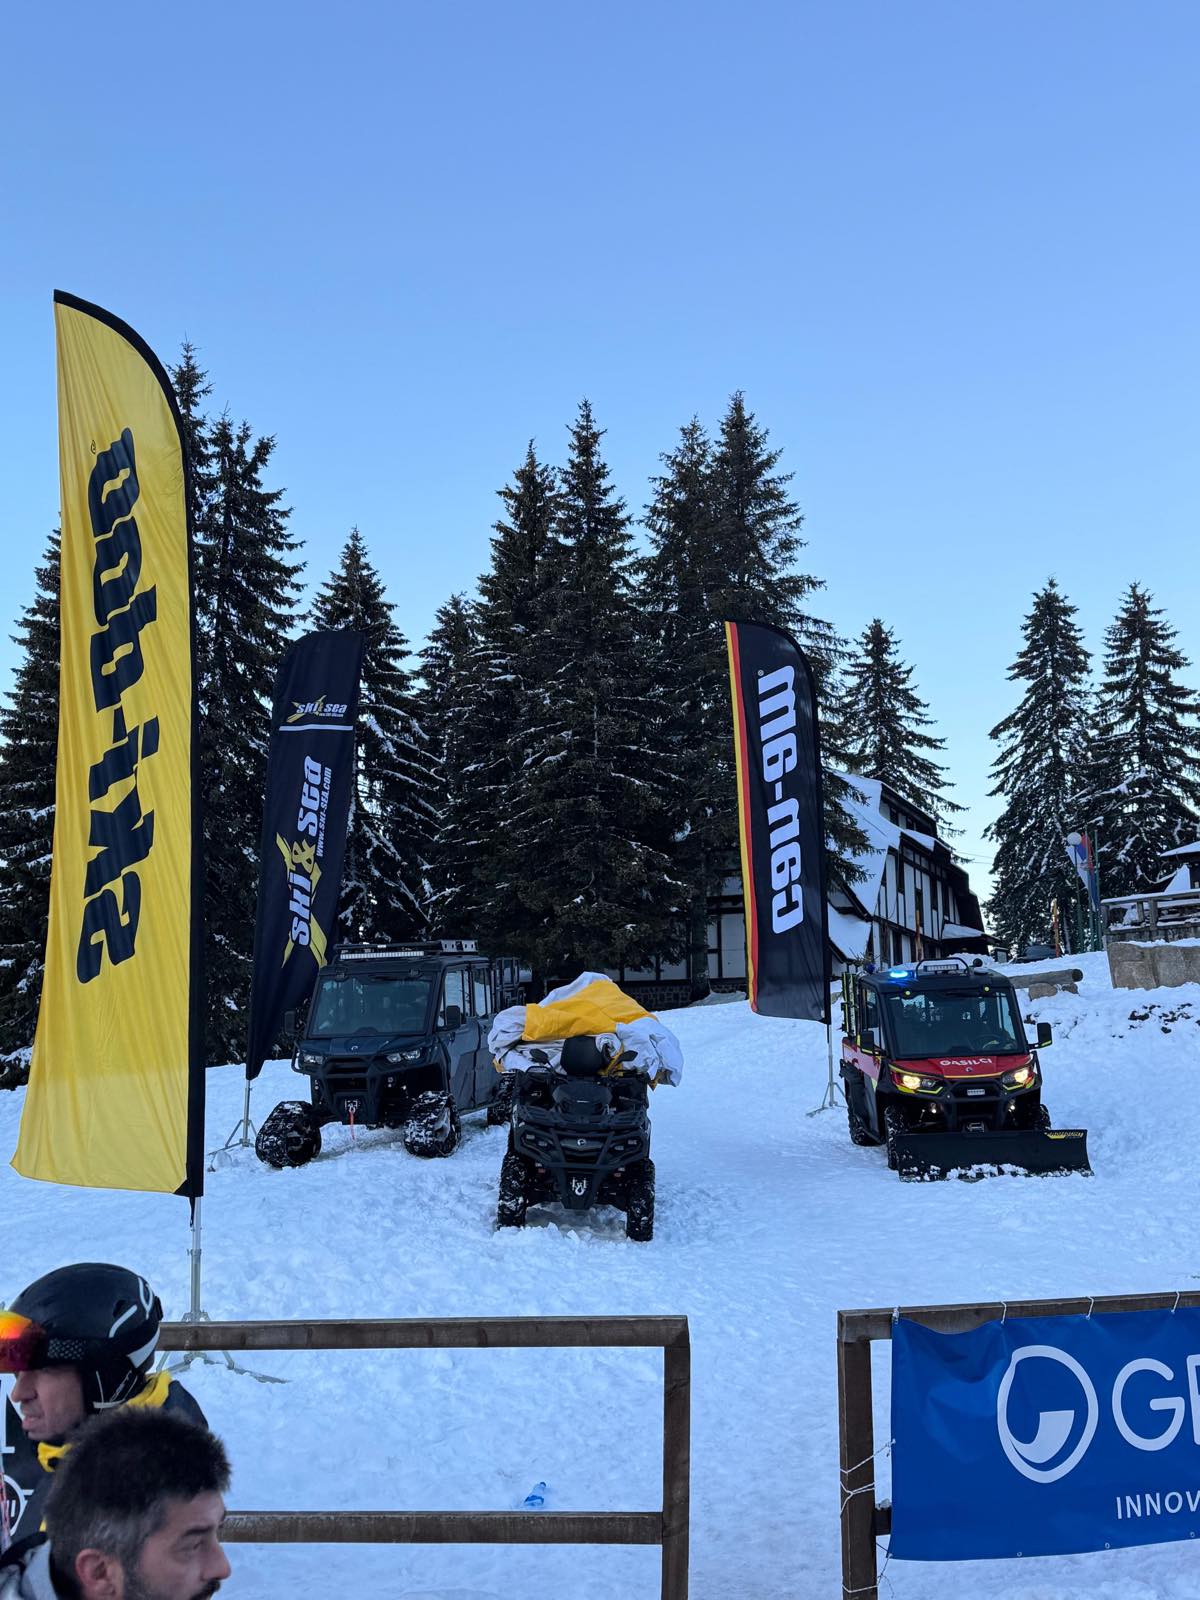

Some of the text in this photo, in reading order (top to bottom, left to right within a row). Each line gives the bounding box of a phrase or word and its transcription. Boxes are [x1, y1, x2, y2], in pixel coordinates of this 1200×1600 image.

[291, 839, 315, 873] &
[1111, 1354, 1200, 1451] G
[1116, 1491, 1200, 1520] INNOV
